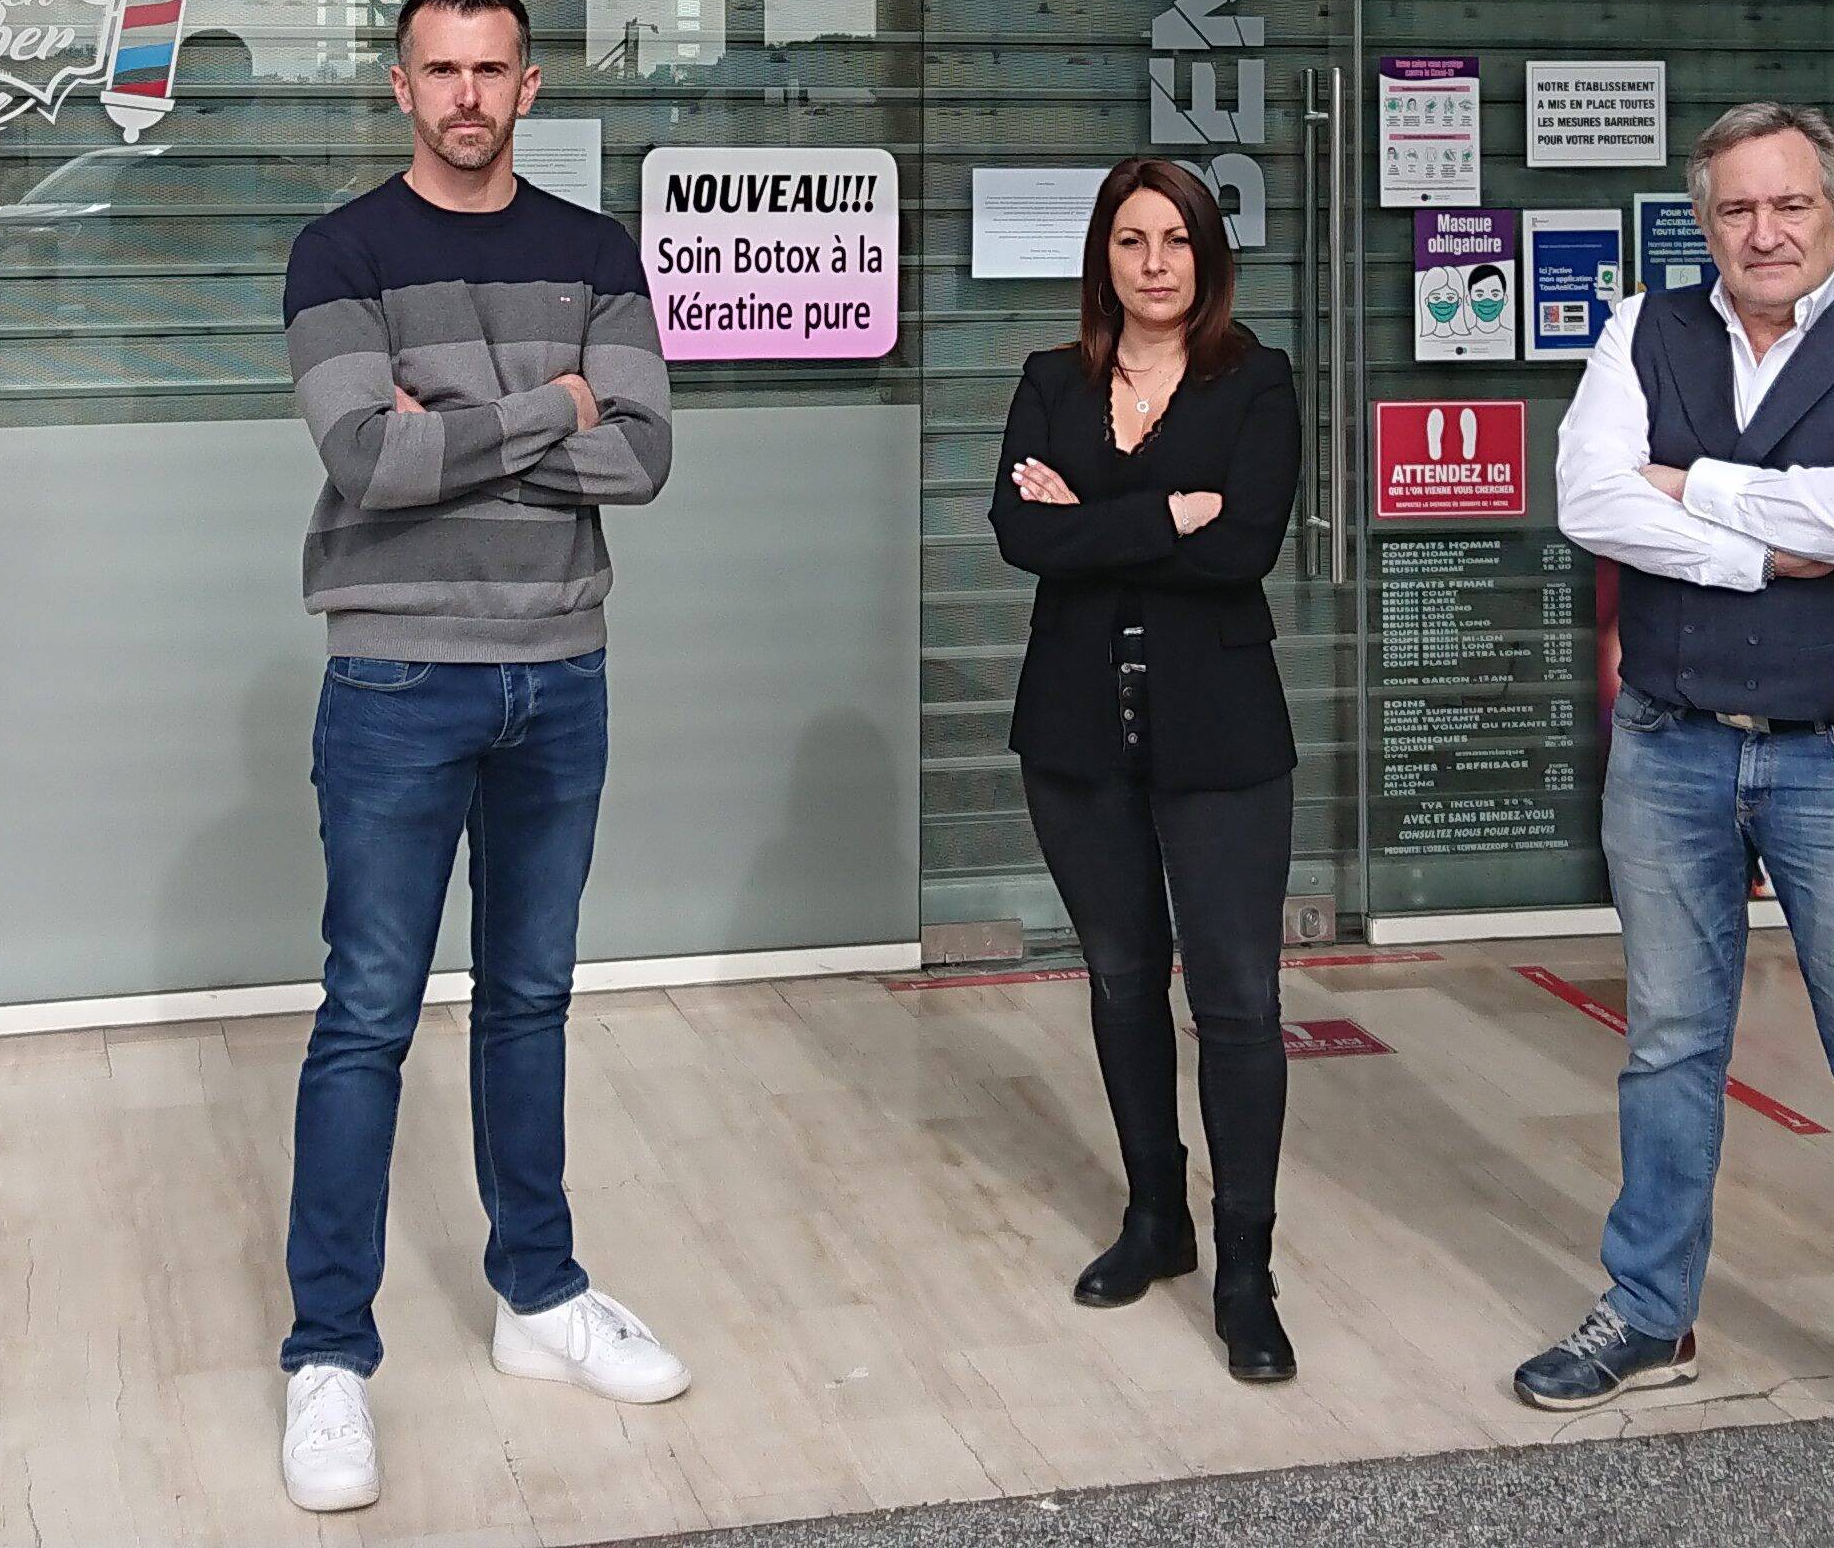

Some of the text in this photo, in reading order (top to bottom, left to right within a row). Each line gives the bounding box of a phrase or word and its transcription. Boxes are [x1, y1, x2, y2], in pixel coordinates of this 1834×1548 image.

[1537, 79, 1655, 92] NOTRE ÉTABLISSEMENT
[1537, 99, 1655, 110] A MIS EN PLACE TOUTES
[1537, 116, 1655, 127] LES MESURES BARRIÈRES
[1537, 134, 1655, 145] POUR VOTRE PROTECTION
[665, 173, 877, 214] NOUVEAU!!!
[1437, 214, 1492, 233] Masque
[1677, 227, 1701, 235] SÉCUR
[1428, 234, 1502, 256] obligatoire
[657, 236, 883, 275] Soin Botox à la
[667, 293, 871, 338] Kératine pure
[1392, 463, 1510, 483] ATTENDEZ ICI
[1388, 485, 1514, 496] QUE L'ON VIENNE VOUS CHERCHER
[1382, 541, 1501, 551] FORFAITS HOMME
[1382, 558, 1454, 566] PERMANENTE
[1382, 580, 1494, 589] FORFAITS FEMME
[1422, 677, 1470, 685] GARÇON
[1384, 700, 1426, 708] SOINS
[1426, 707, 1483, 715] SUPERIEUR
[1384, 724, 1428, 732] MOUSSE
[1383, 735, 1468, 745] TECHNIQUES
[1385, 760, 1529, 772] MECHES DEFRISAGE
[1384, 780, 1434, 788] MI-LONG
[1421, 802, 1443, 810] TVA
[1451, 800, 1495, 808] INCLUSE
[1403, 808, 1555, 825] AVEC ET SANS RENDEZ-VOUS
[1399, 824, 1555, 840] CONSULTEZ NOUS POUR UN DEVIS
